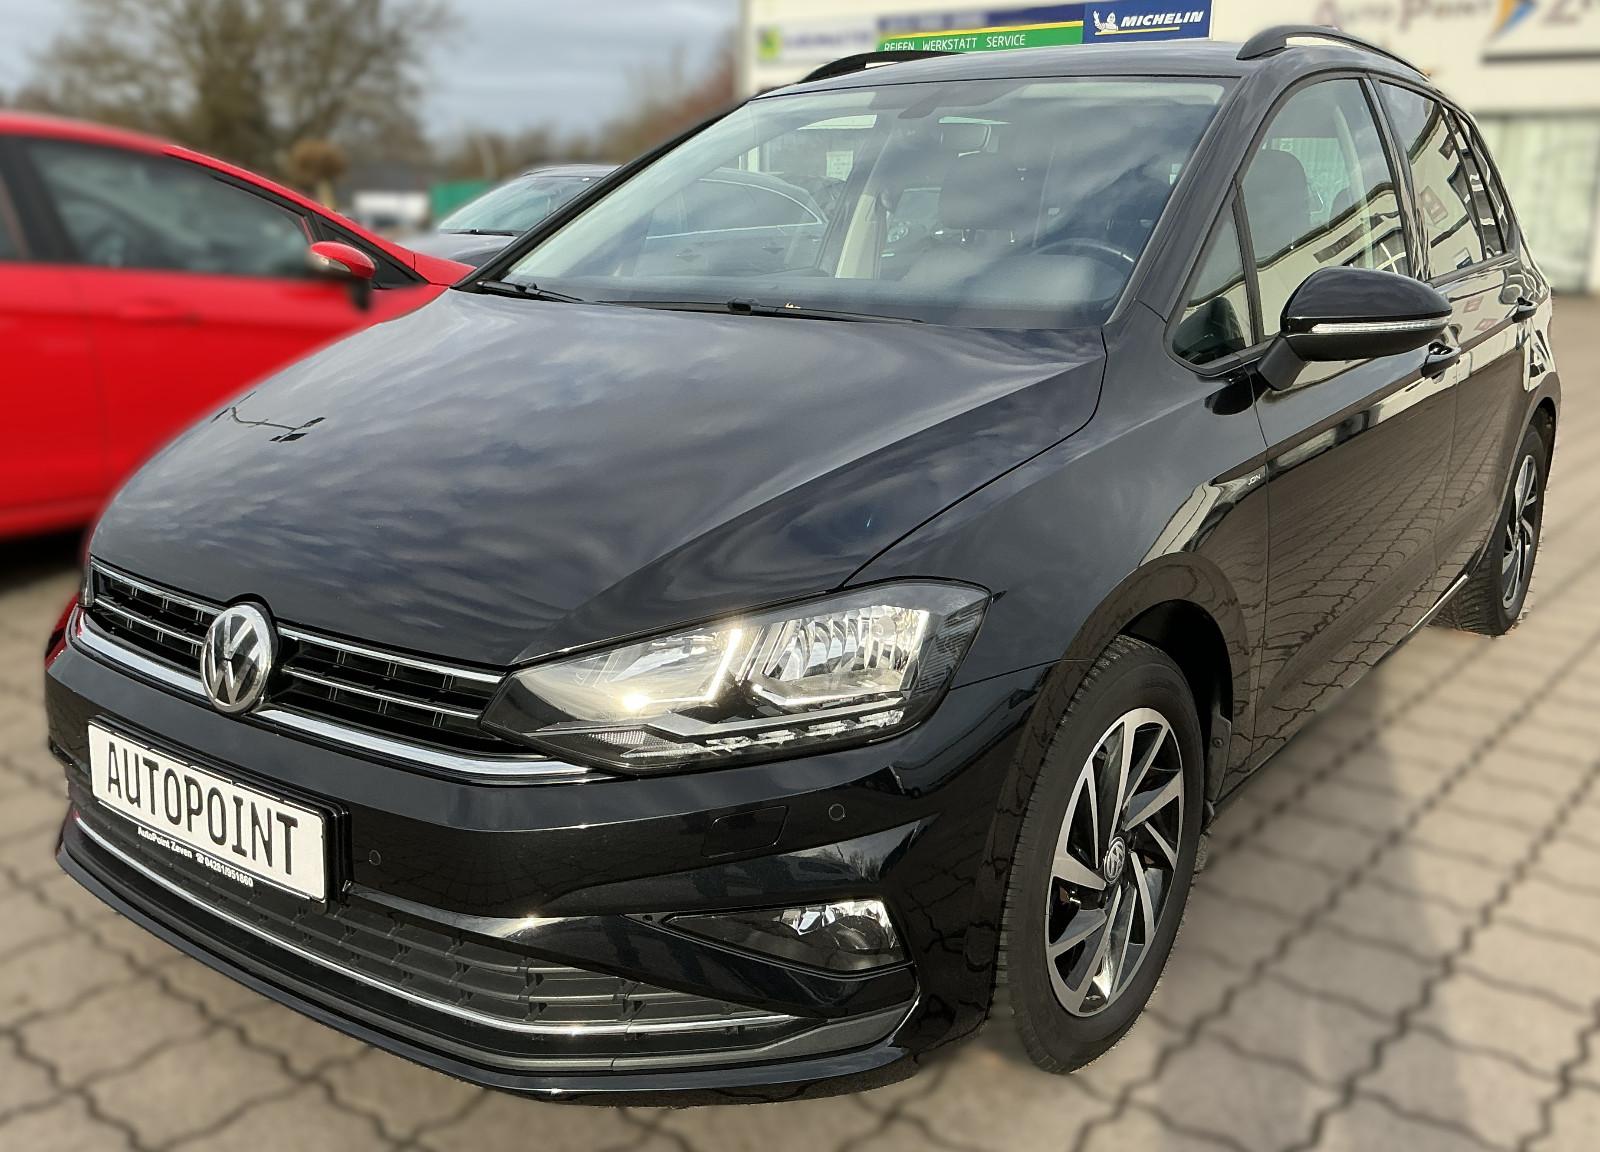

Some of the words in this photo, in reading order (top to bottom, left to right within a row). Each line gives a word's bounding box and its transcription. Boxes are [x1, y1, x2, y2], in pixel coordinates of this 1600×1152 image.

[1120, 11, 1204, 27] MICHELIN
[922, 37, 978, 51] WERKSTATT
[986, 34, 1026, 47] SERVICE
[107, 741, 298, 875] AUTOPOINT
[137, 826, 170, 849] AutoPoint
[170, 840, 193, 859] Zeven
